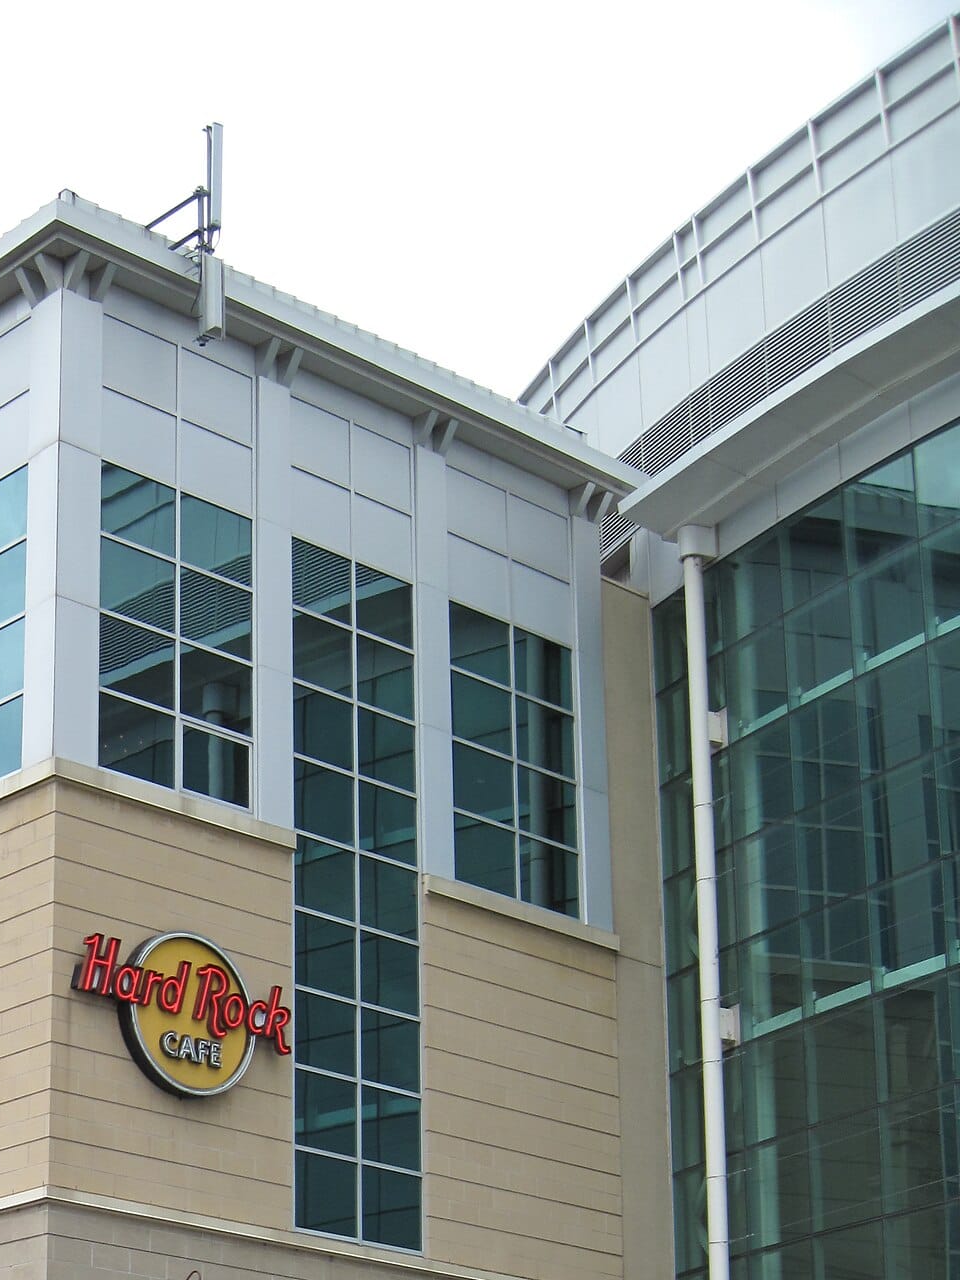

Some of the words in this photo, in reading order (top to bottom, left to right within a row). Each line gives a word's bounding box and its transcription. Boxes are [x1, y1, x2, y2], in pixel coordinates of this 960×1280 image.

[83, 933, 192, 1015] Hard
[192, 964, 292, 1055] Rock
[160, 1030, 223, 1068] CAFE
